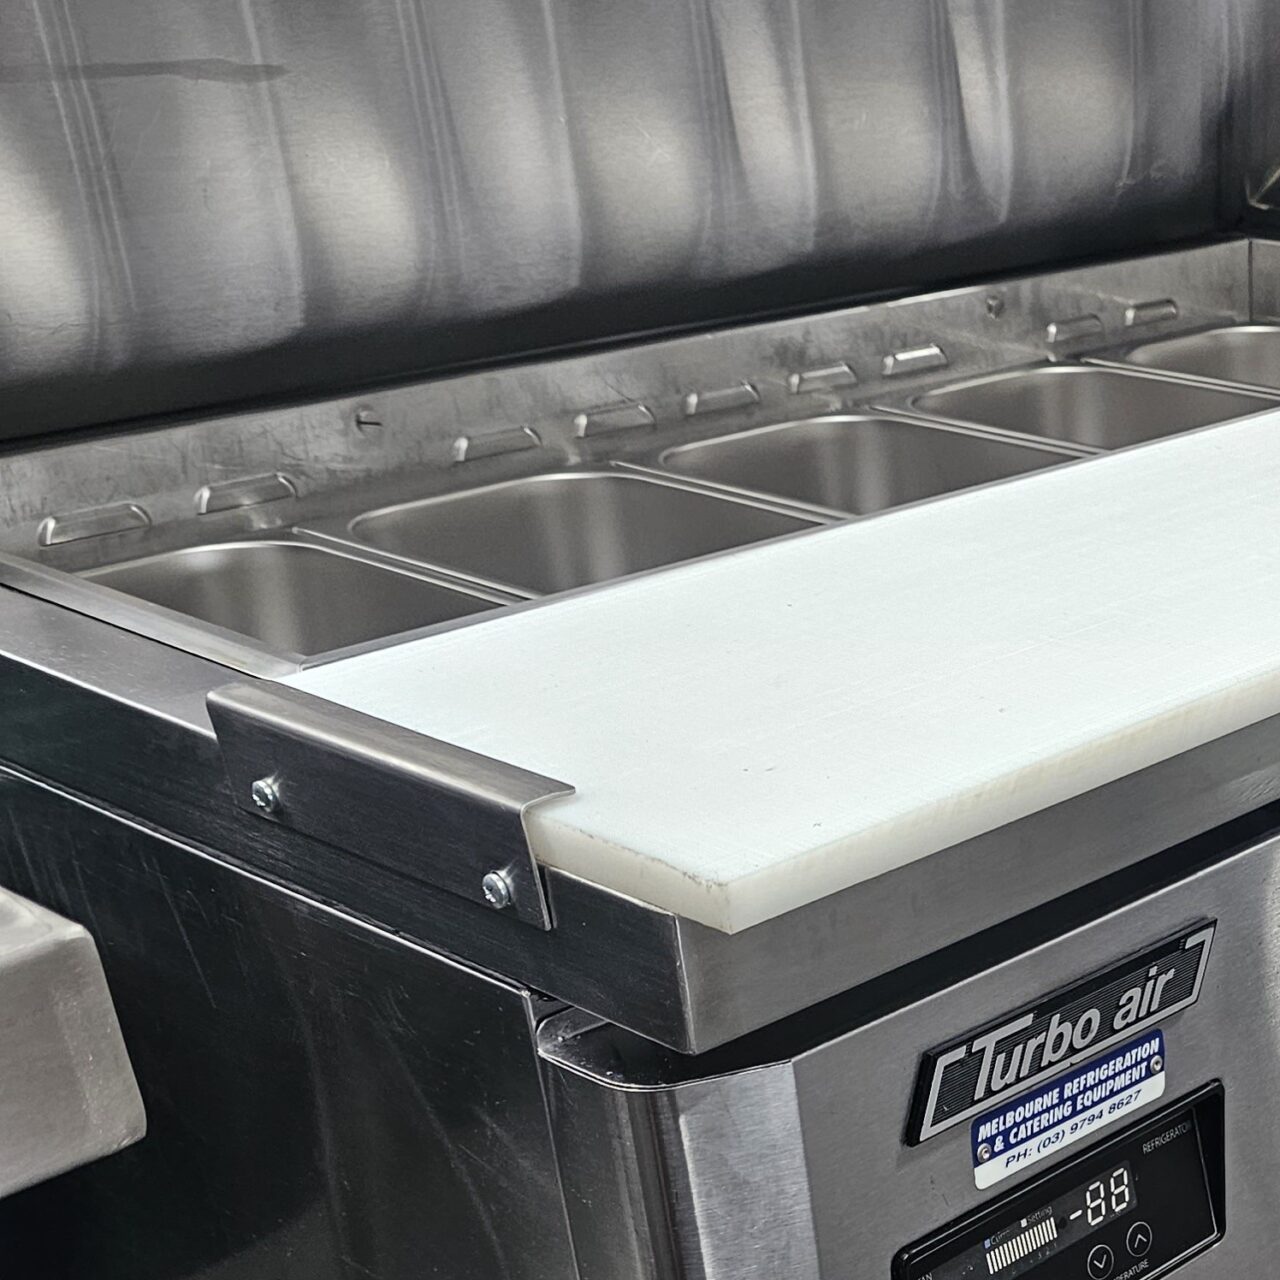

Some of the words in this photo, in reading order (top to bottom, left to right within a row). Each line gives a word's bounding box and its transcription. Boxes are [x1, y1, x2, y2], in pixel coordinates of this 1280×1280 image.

[972, 1008, 1101, 1101] Turbo
[1113, 965, 1175, 1030] air
[978, 1088, 1060, 1142] MELBOURNE
[1063, 1037, 1161, 1097] REFRIGERATION
[993, 1136, 1005, 1152] &
[1009, 1103, 1072, 1144] CATERING
[1076, 1061, 1148, 1111] EQUIPMENT
[1005, 1147, 1034, 1167] PH:
[1037, 1129, 1065, 1152] (03)
[1070, 1111, 1103, 1135] 9794
[1108, 1089, 1142, 1114] 8627
